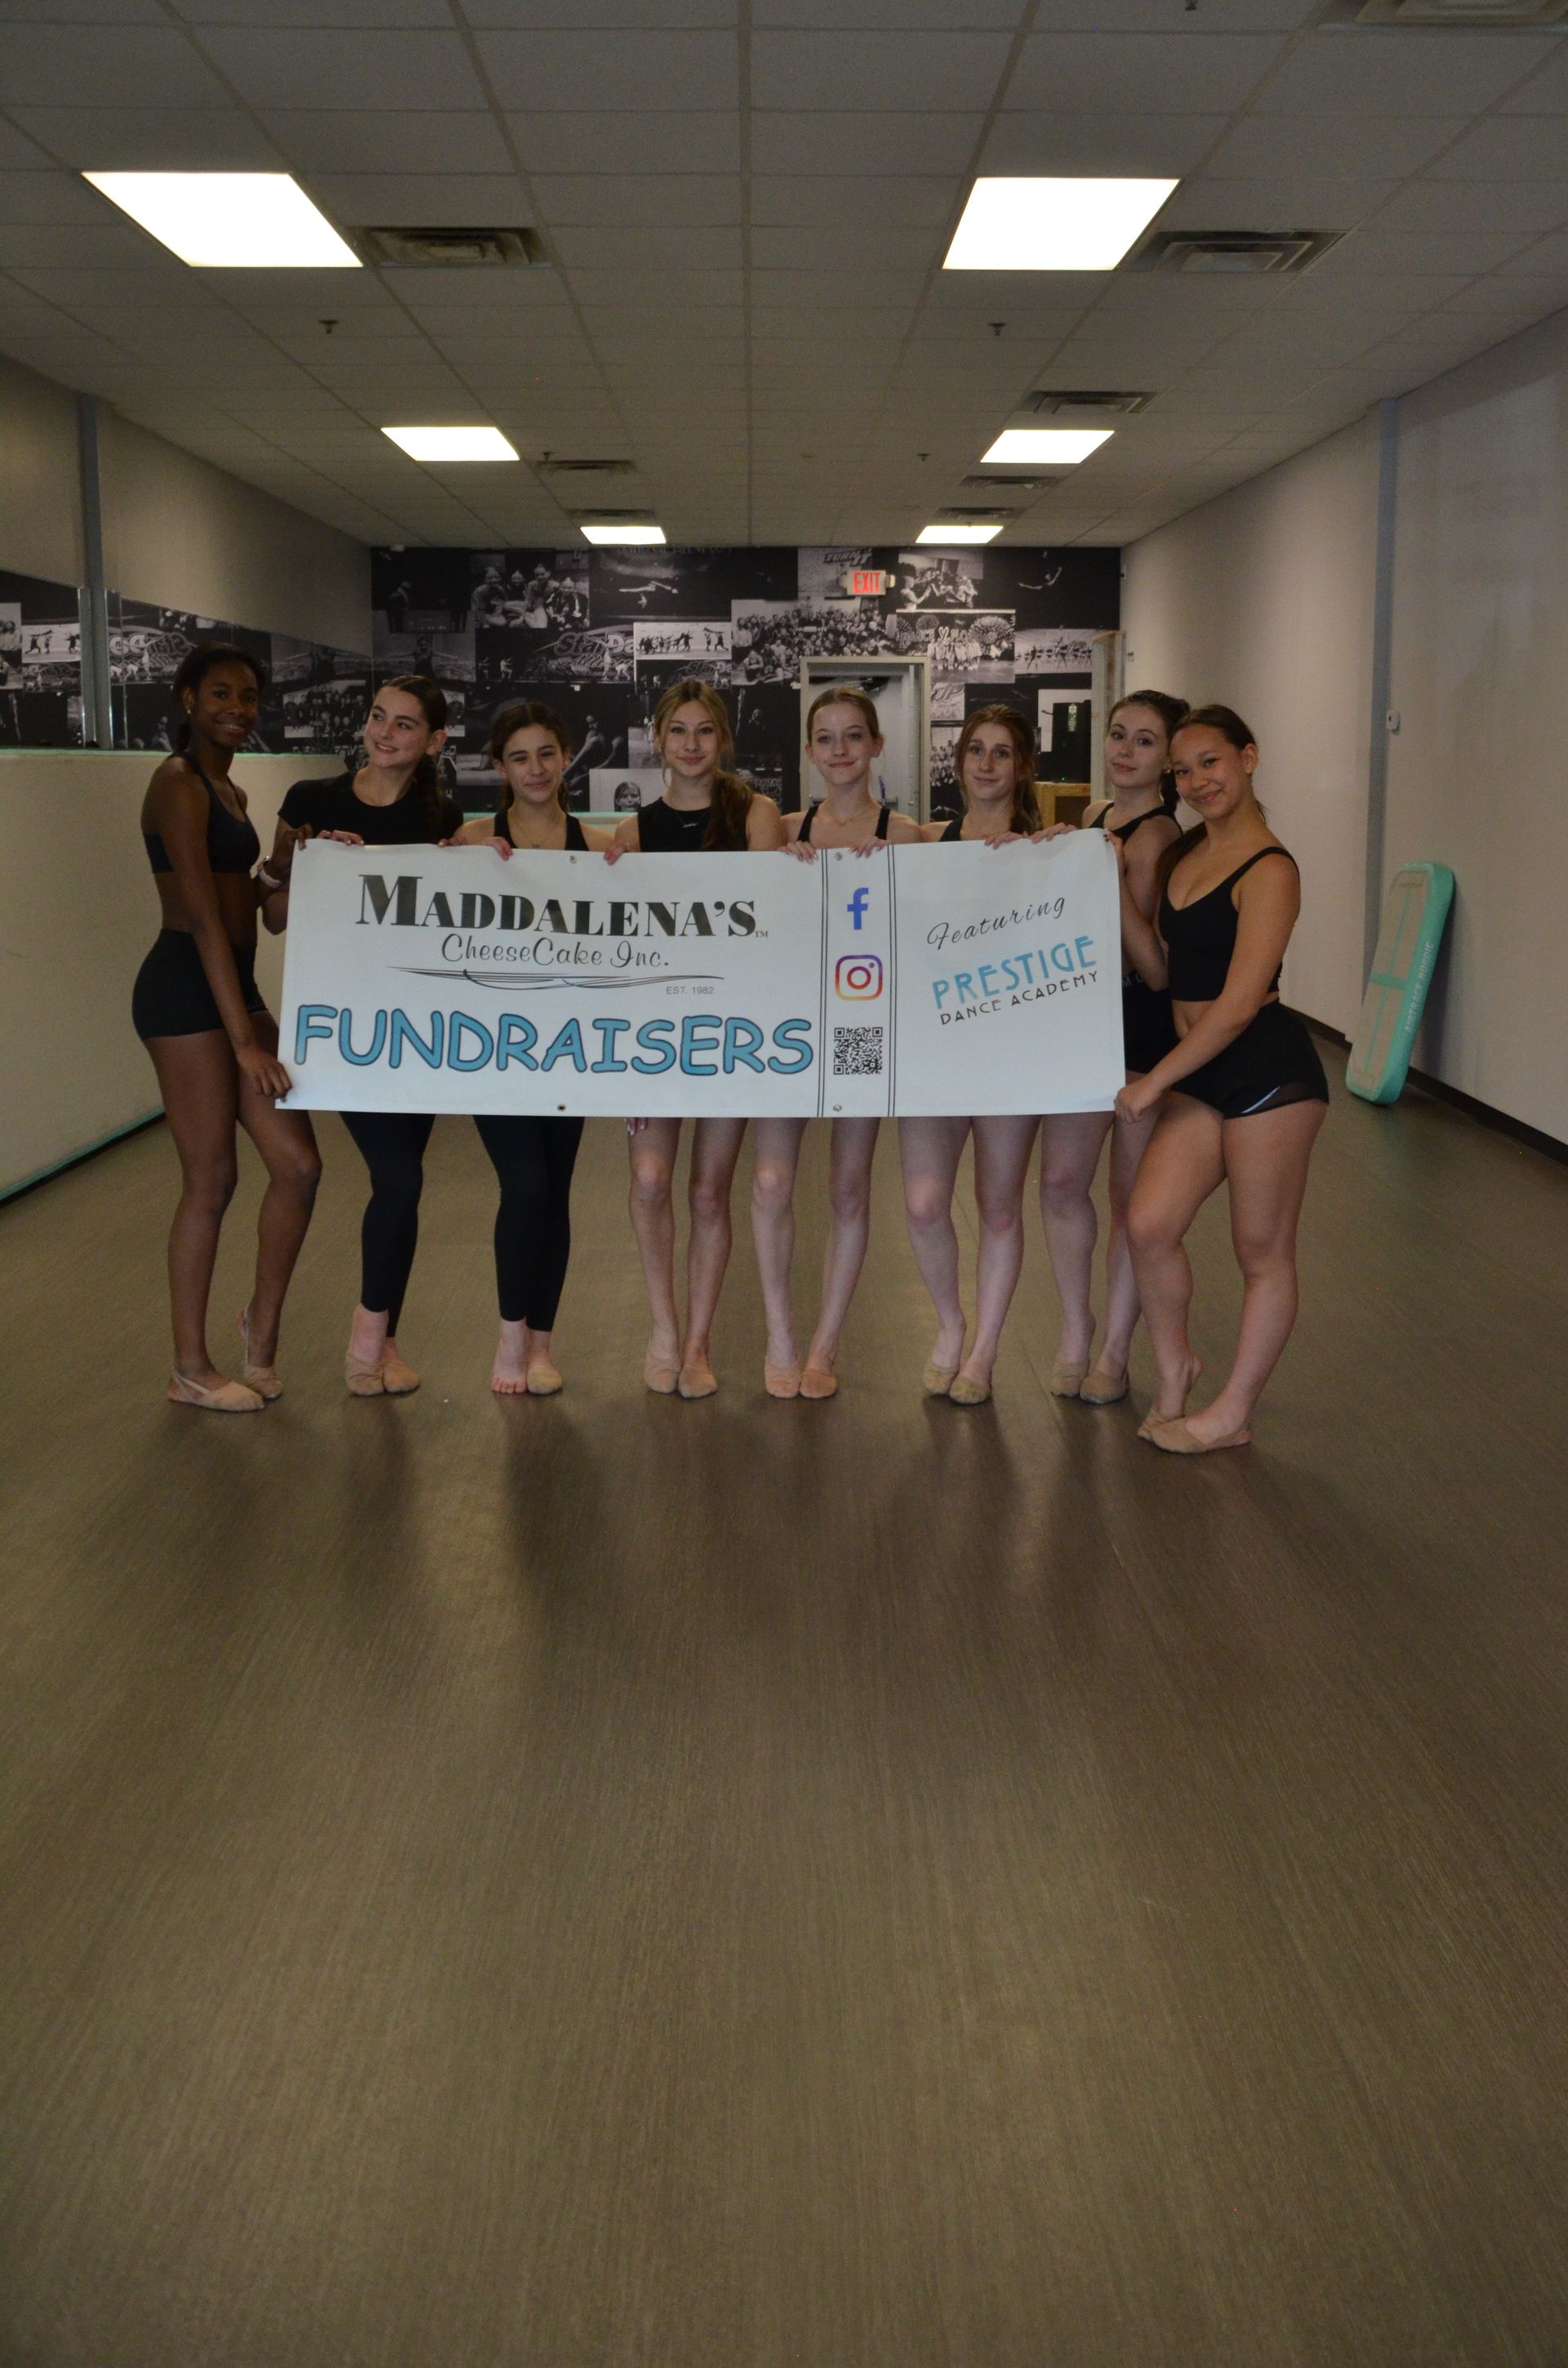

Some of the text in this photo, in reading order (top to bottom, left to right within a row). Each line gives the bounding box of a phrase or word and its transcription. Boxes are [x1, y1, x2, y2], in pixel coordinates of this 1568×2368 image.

[853, 572, 880, 592] EXIT
[355, 874, 756, 937] MADDALENA'S
[927, 897, 1065, 950] Featuring
[442, 934, 669, 968] CheeseCake Inc.
[932, 935, 1097, 1010] PRESTIGE
[1418, 941, 1434, 979] NORDIC
[666, 986, 714, 995] EST. 1982
[940, 999, 1002, 1025] DANCE
[1011, 970, 1098, 1006] ACADEMY
[294, 1005, 813, 1076] FUNDRAISERS
